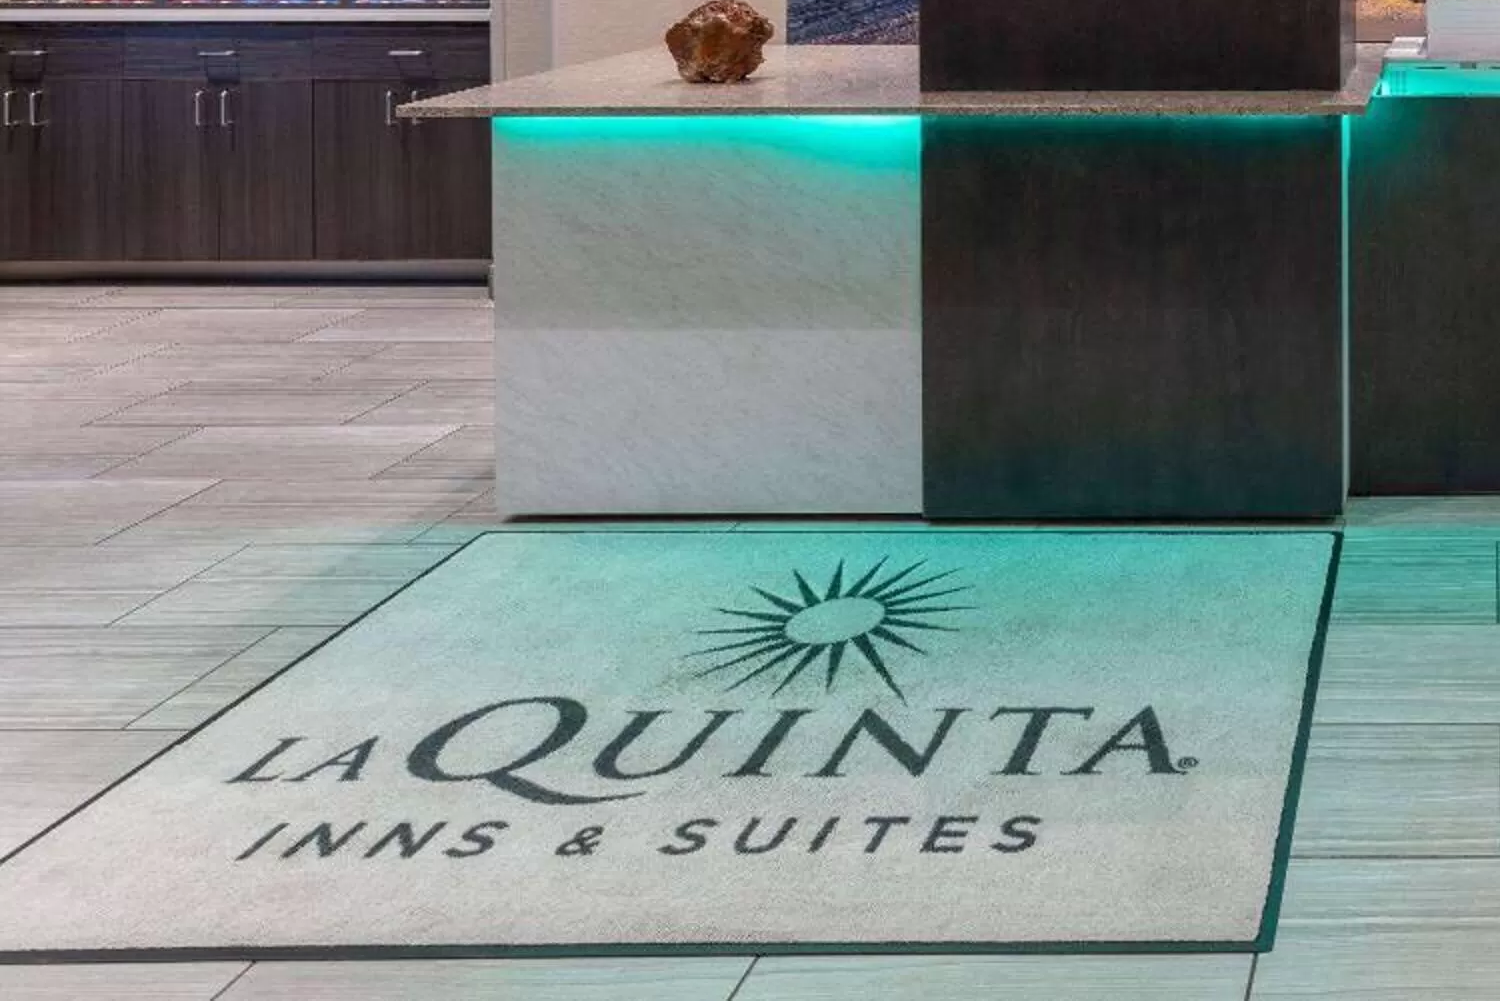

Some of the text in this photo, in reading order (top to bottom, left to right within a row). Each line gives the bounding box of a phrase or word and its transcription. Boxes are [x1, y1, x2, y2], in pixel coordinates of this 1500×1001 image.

[227, 736, 380, 784] LA
[236, 814, 1043, 861] INNS & SUITES
